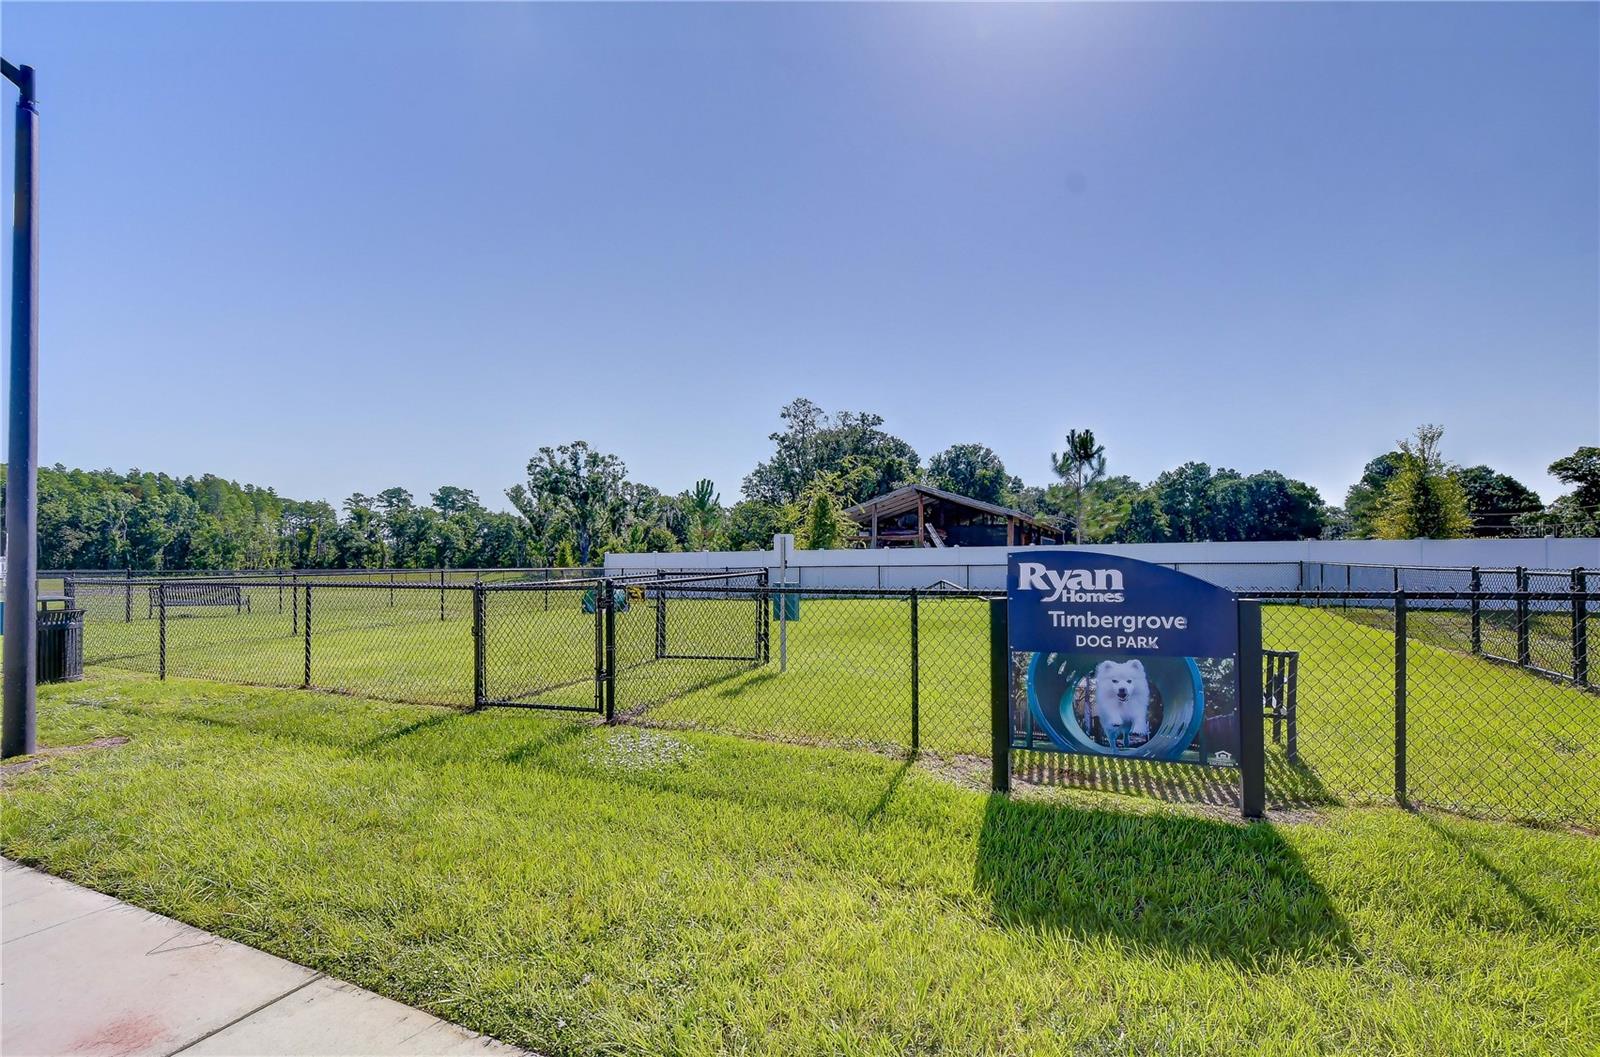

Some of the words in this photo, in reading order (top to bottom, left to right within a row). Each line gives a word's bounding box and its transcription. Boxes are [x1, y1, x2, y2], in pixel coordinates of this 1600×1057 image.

[1017, 562, 1125, 602] Ryan
[1061, 589, 1125, 603] Homes
[1048, 610, 1187, 633] Timbergrove
[1075, 635, 1113, 648] DOG
[1117, 636, 1159, 649] PARK
